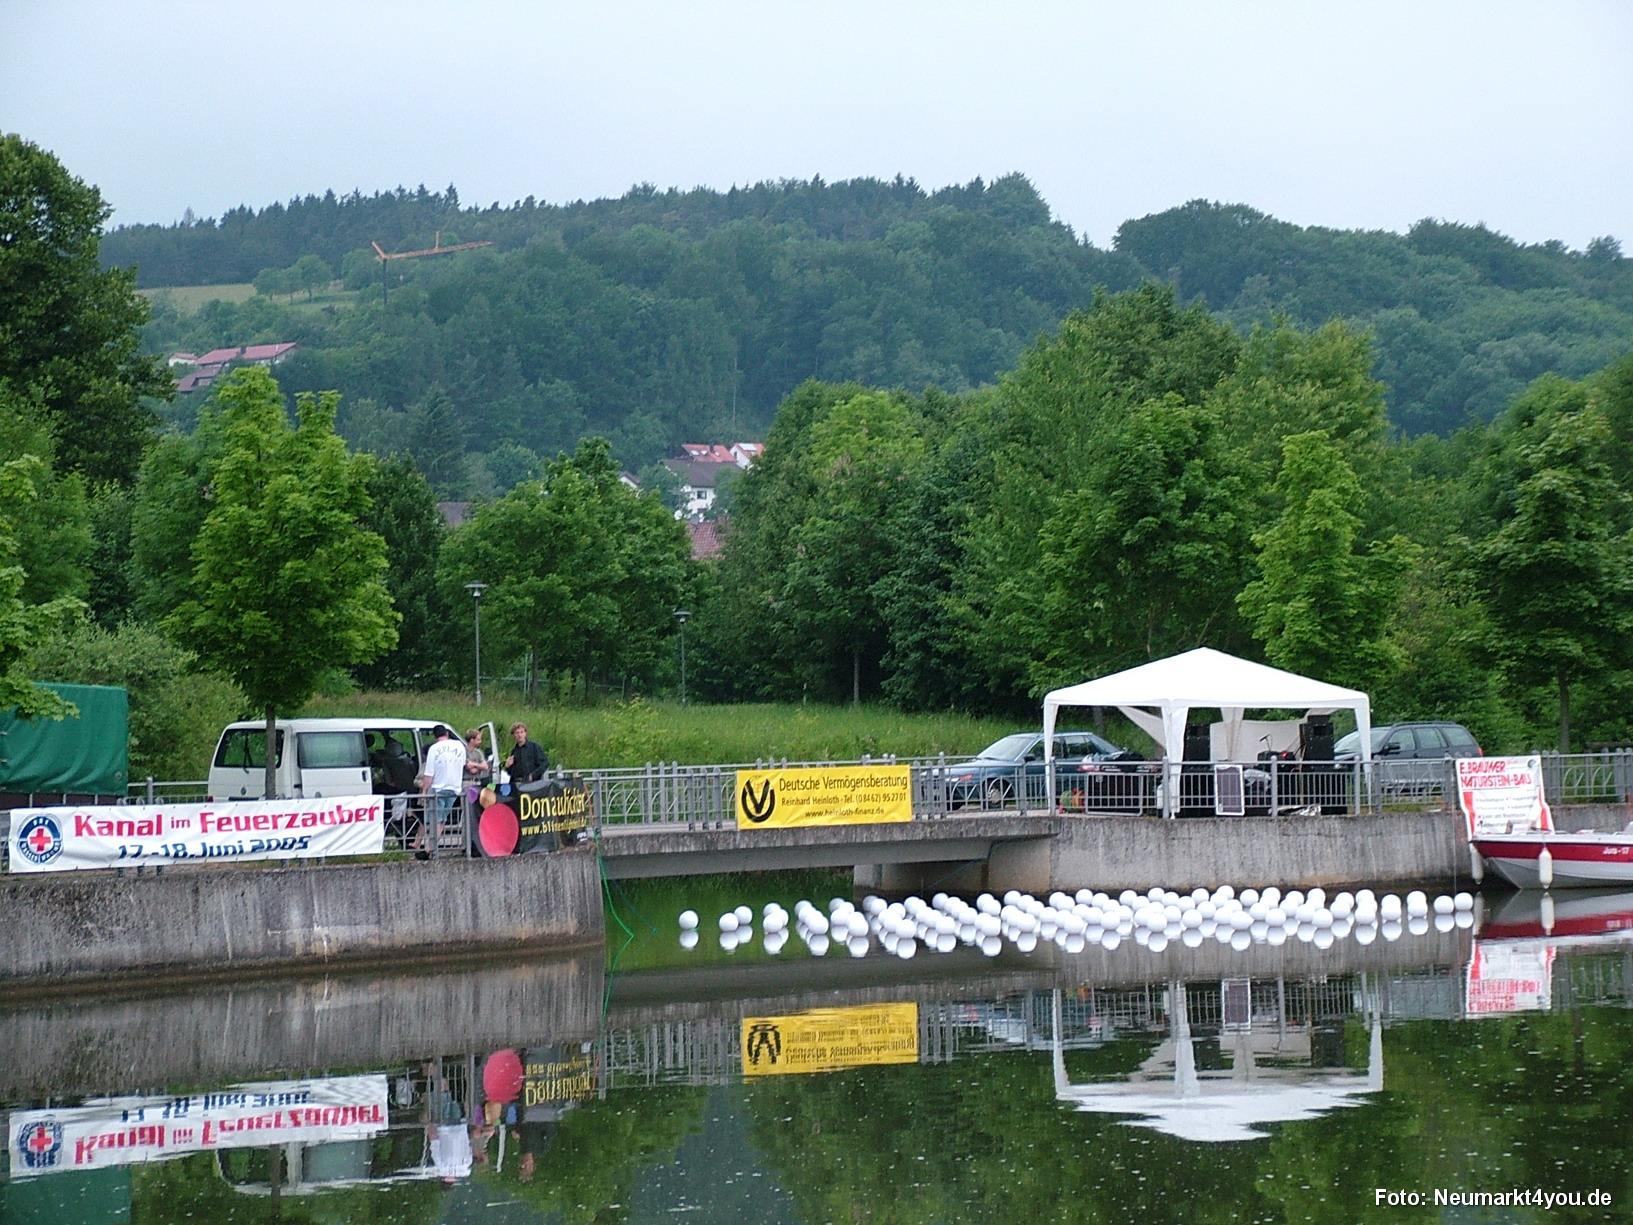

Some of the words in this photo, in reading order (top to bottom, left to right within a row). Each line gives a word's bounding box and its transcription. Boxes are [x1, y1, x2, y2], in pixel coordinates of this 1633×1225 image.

[779, 776, 820, 791] Deutsche
[823, 774, 908, 792] Vermögensberatung
[781, 796, 811, 806] Reinhard
[812, 795, 840, 805] Heinloth
[74, 812, 163, 838] Kanal
[170, 816, 191, 829] im
[200, 803, 380, 833] Feuerzauber
[250, 834, 311, 853] 2005
